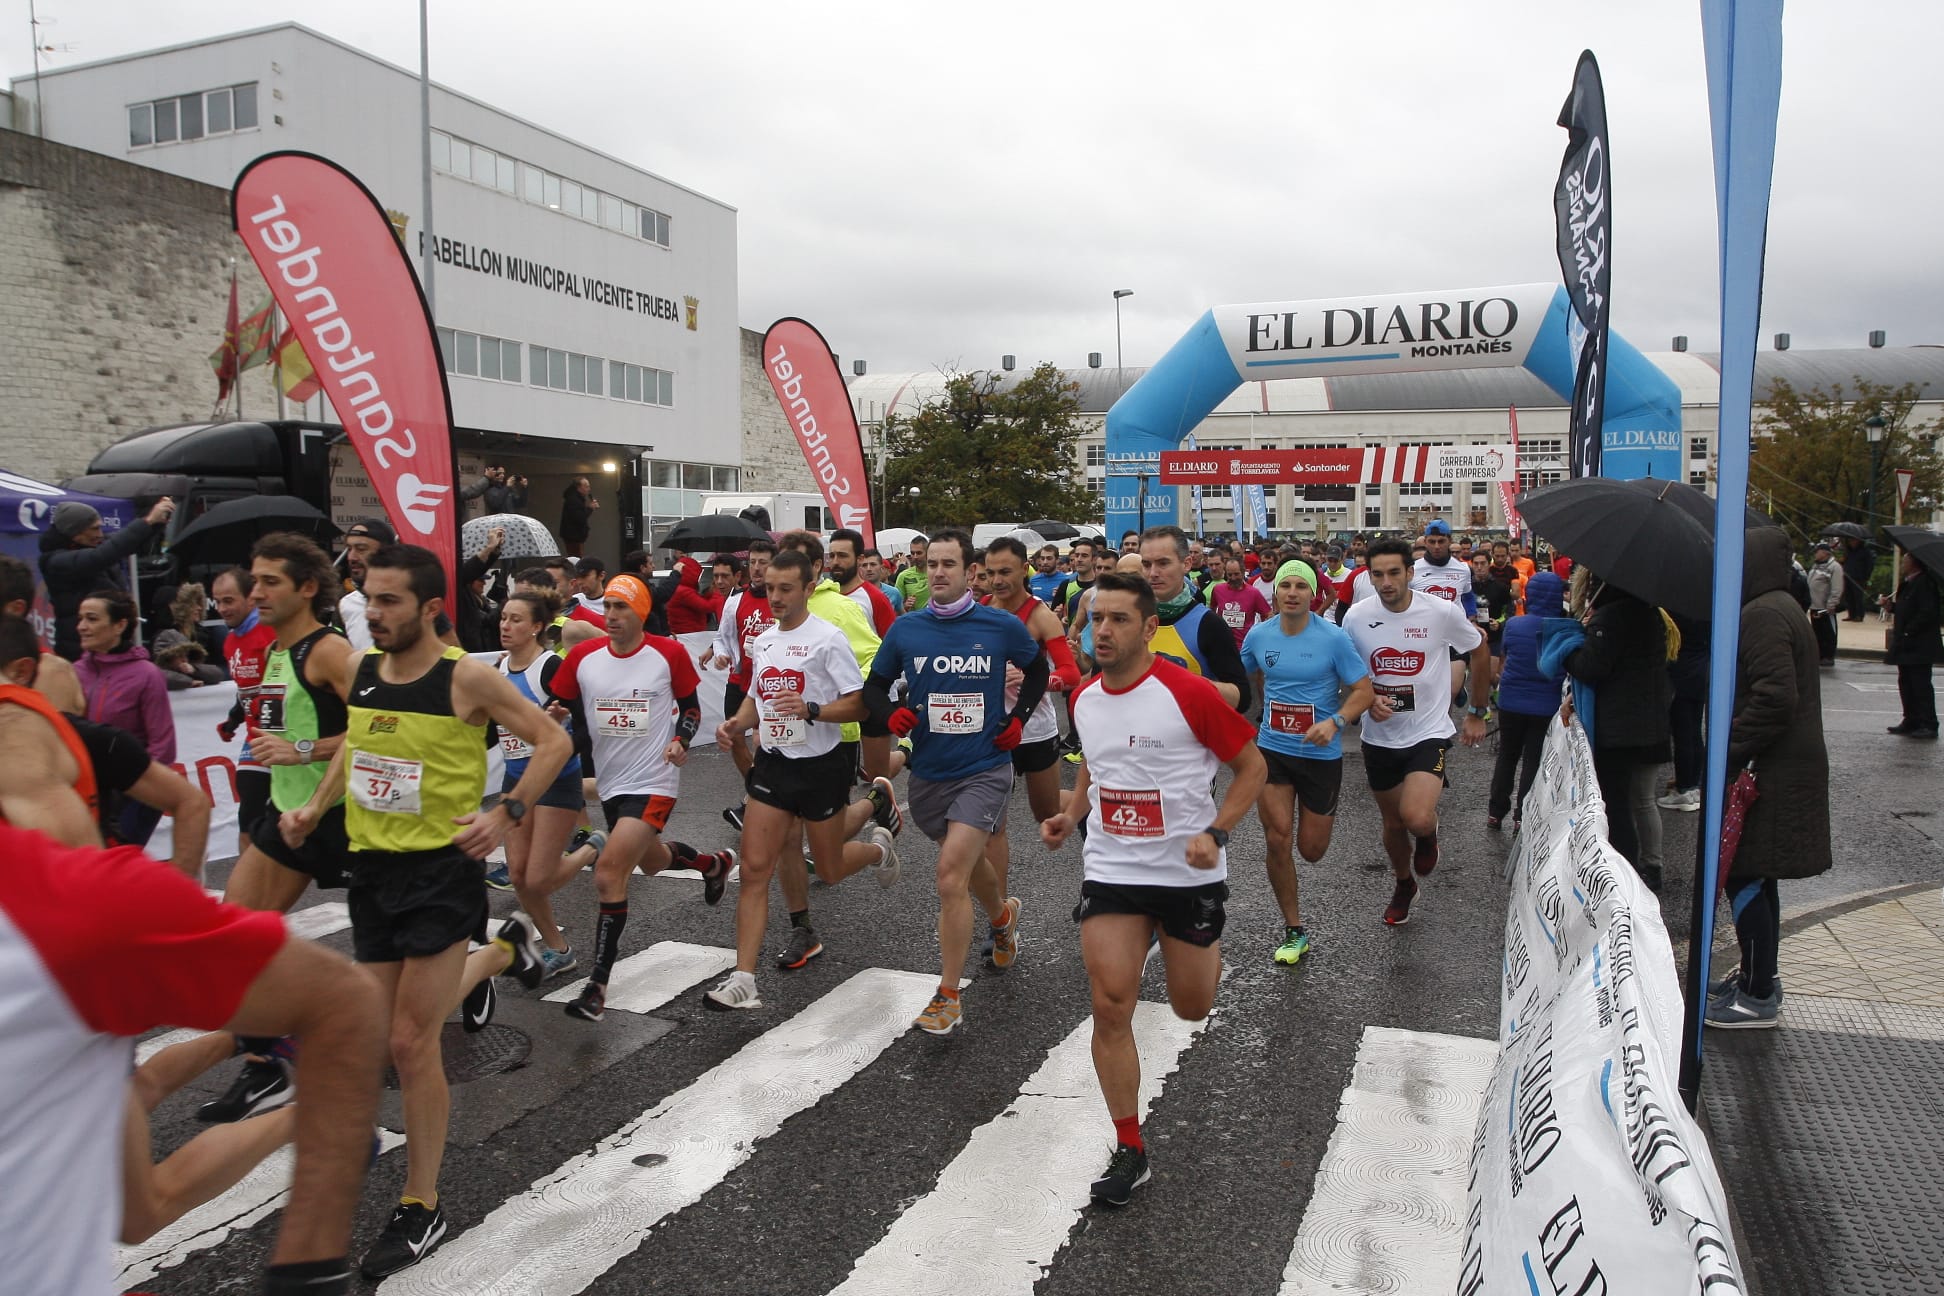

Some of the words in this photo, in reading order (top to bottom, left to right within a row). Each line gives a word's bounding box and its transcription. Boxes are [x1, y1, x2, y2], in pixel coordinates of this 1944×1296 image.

[506, 255, 581, 298] MUNICIPAL
[582, 276, 633, 311] VICENTE
[635, 291, 679, 322] TRUEBA
[1245, 312, 1313, 352] EL
[1320, 297, 1519, 348] DIARIO
[1411, 338, 1512, 358] MONTAÑÉS
[1604, 432, 1623, 447] EL
[1625, 430, 1680, 447] DIARIO
[1169, 462, 1182, 471] EL
[1183, 462, 1218, 471] DIARIO
[1304, 463, 1350, 473] Santander
[1440, 456, 1473, 467] CARRERA
[1475, 455, 1485, 466] DE
[1440, 468, 1453, 478] LAS
[1455, 467, 1496, 478] EMPRESAS
[1107, 496, 1120, 509] EL
[1121, 495, 1171, 510] DIRIO
[932, 655, 992, 674] ORAN
